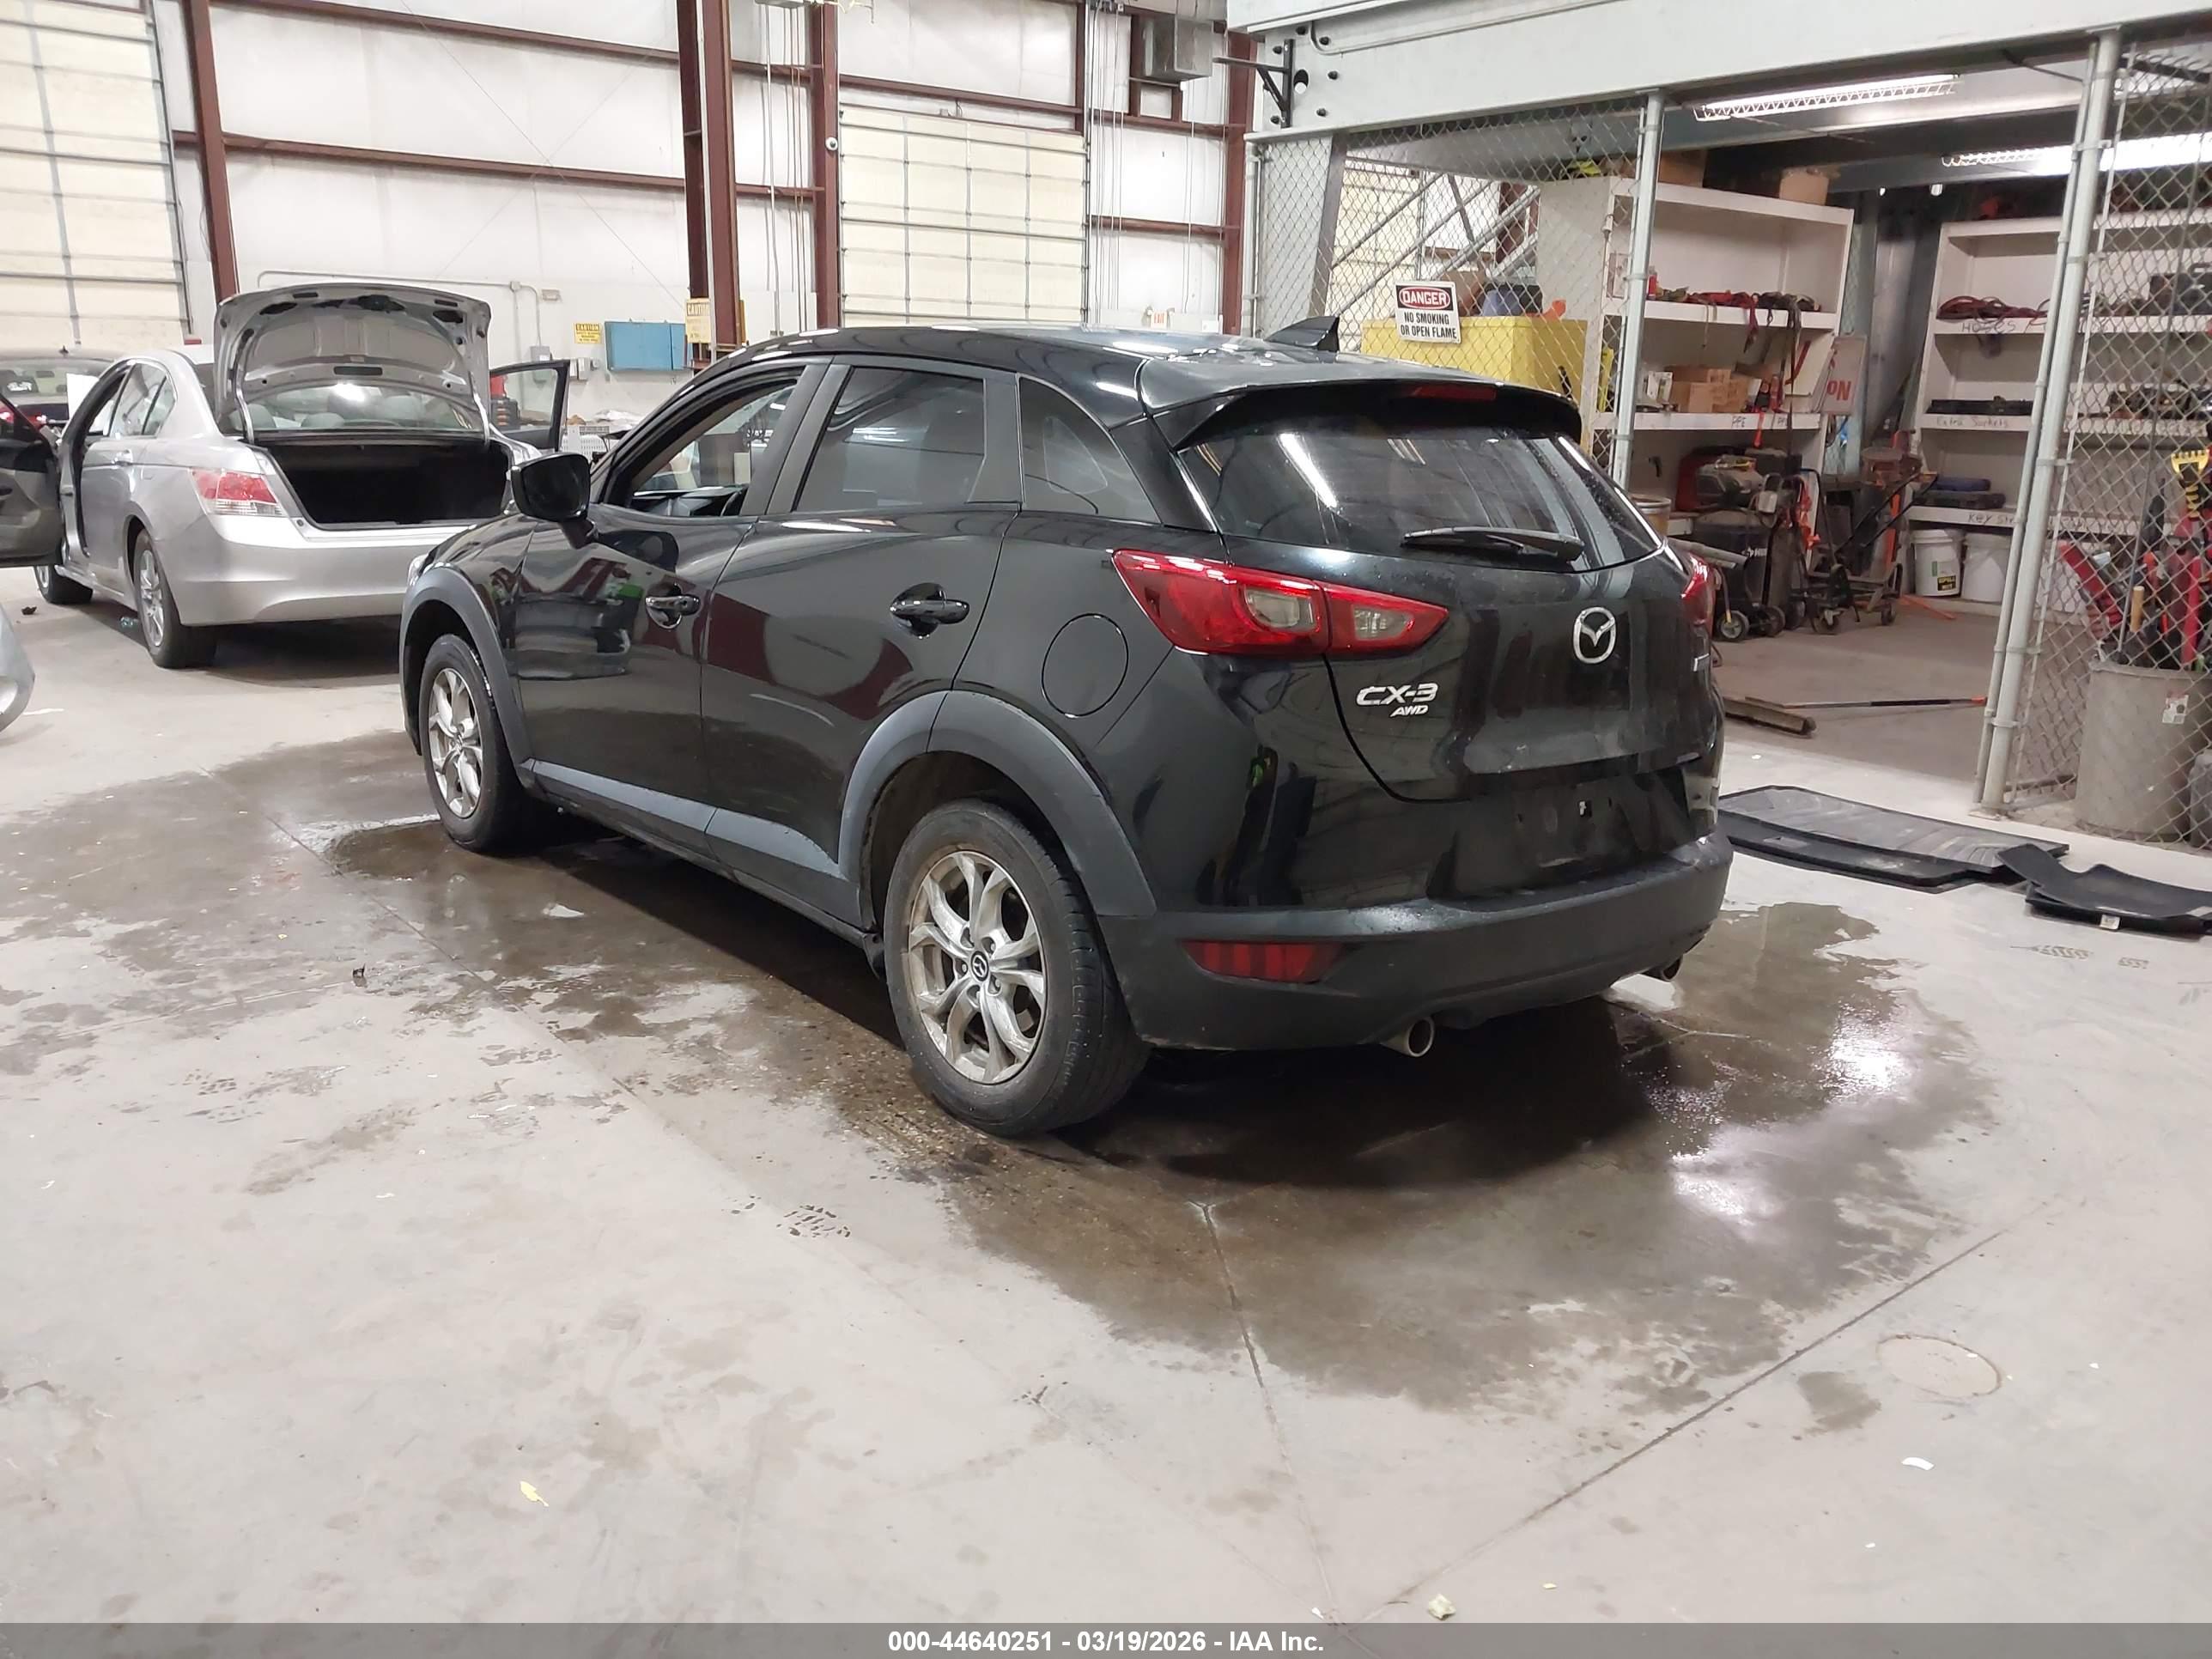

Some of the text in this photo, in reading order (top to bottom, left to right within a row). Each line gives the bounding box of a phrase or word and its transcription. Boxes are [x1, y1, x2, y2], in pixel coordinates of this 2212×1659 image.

[1402, 290, 1447, 306] DANGER
[1404, 312, 1449, 325] NO SMOKING
[1401, 325, 1457, 339] OR OPEN FLAME
[1356, 683, 1438, 706] CX-3
[1389, 704, 1429, 718] AWD
